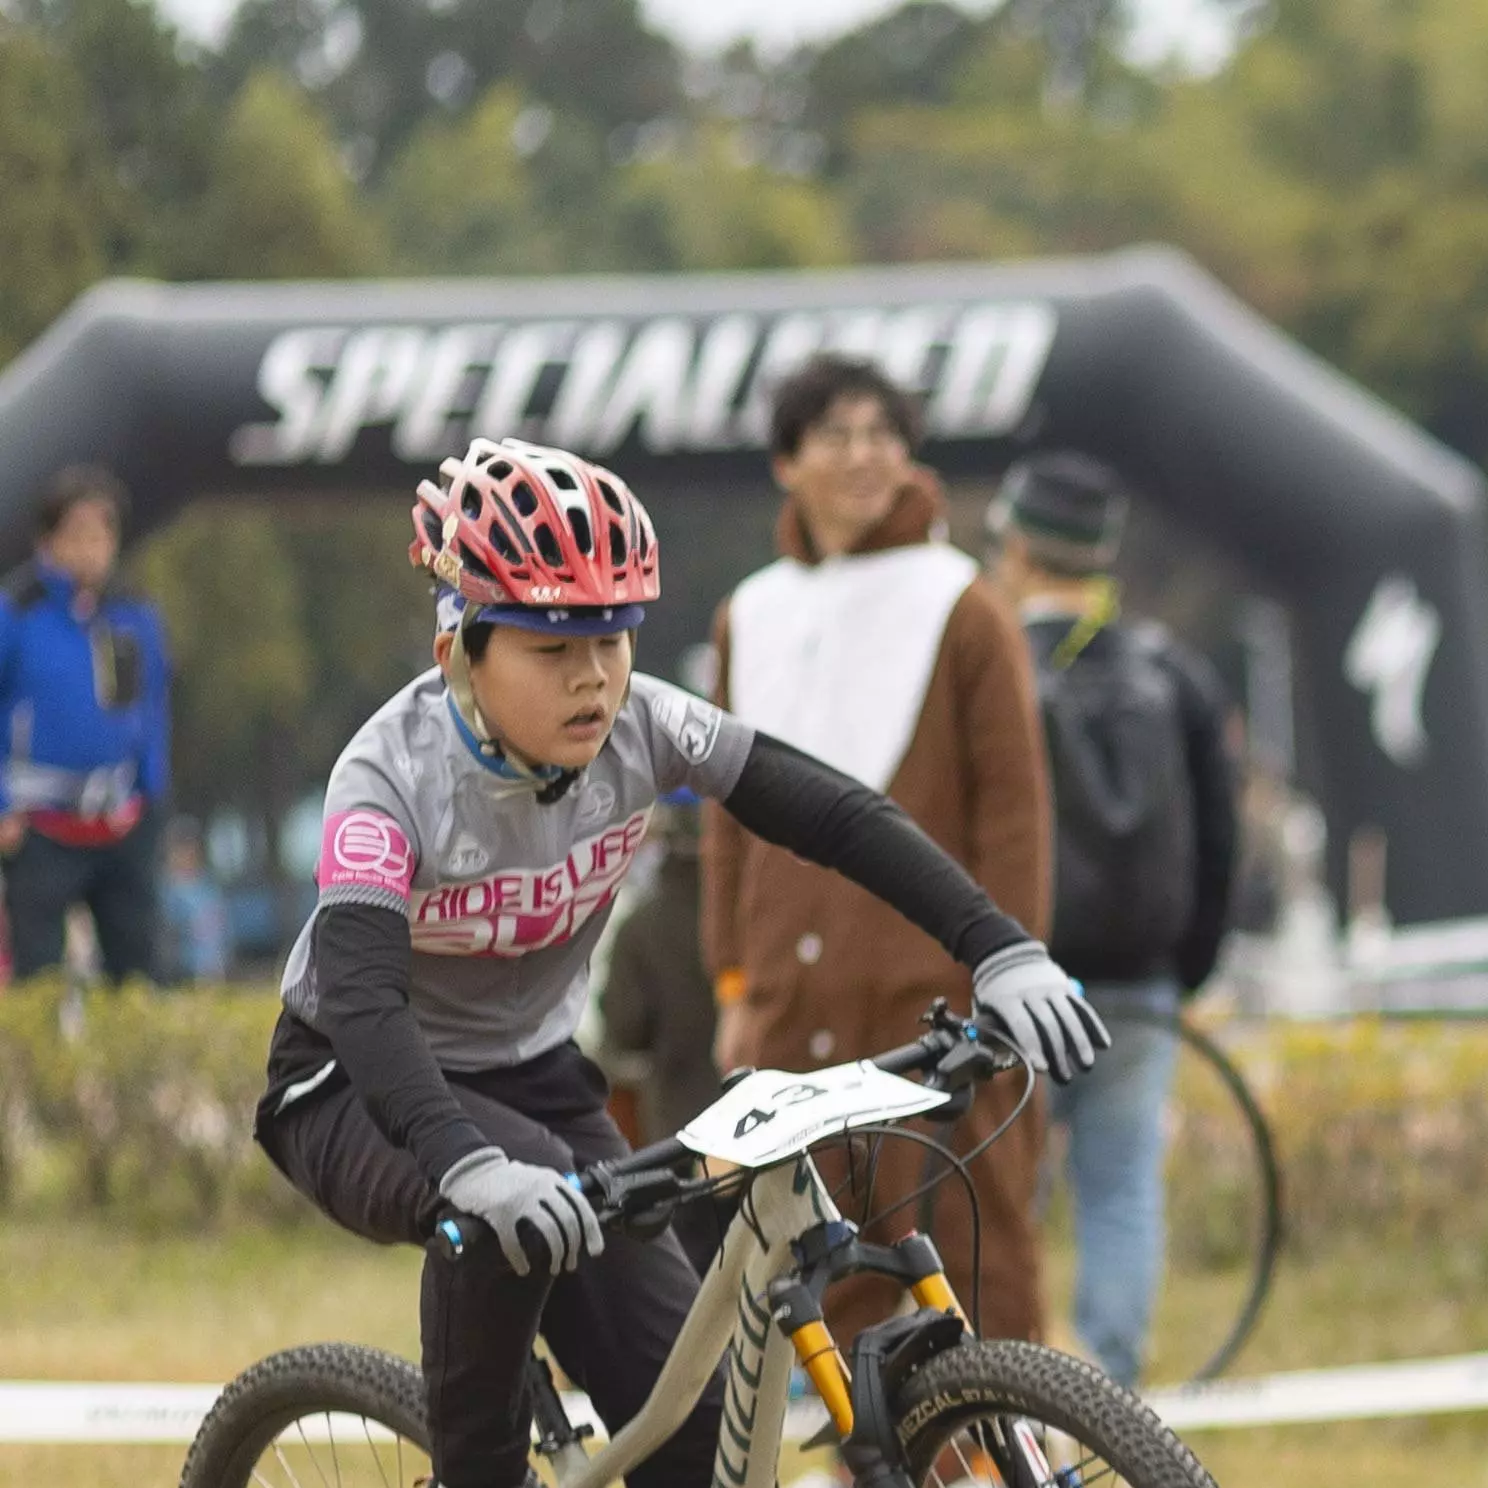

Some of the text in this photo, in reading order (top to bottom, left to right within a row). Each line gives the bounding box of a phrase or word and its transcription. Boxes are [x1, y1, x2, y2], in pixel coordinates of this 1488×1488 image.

[417, 876, 523, 922] RIDE
[533, 869, 565, 909] IS
[565, 813, 645, 889] LIFE
